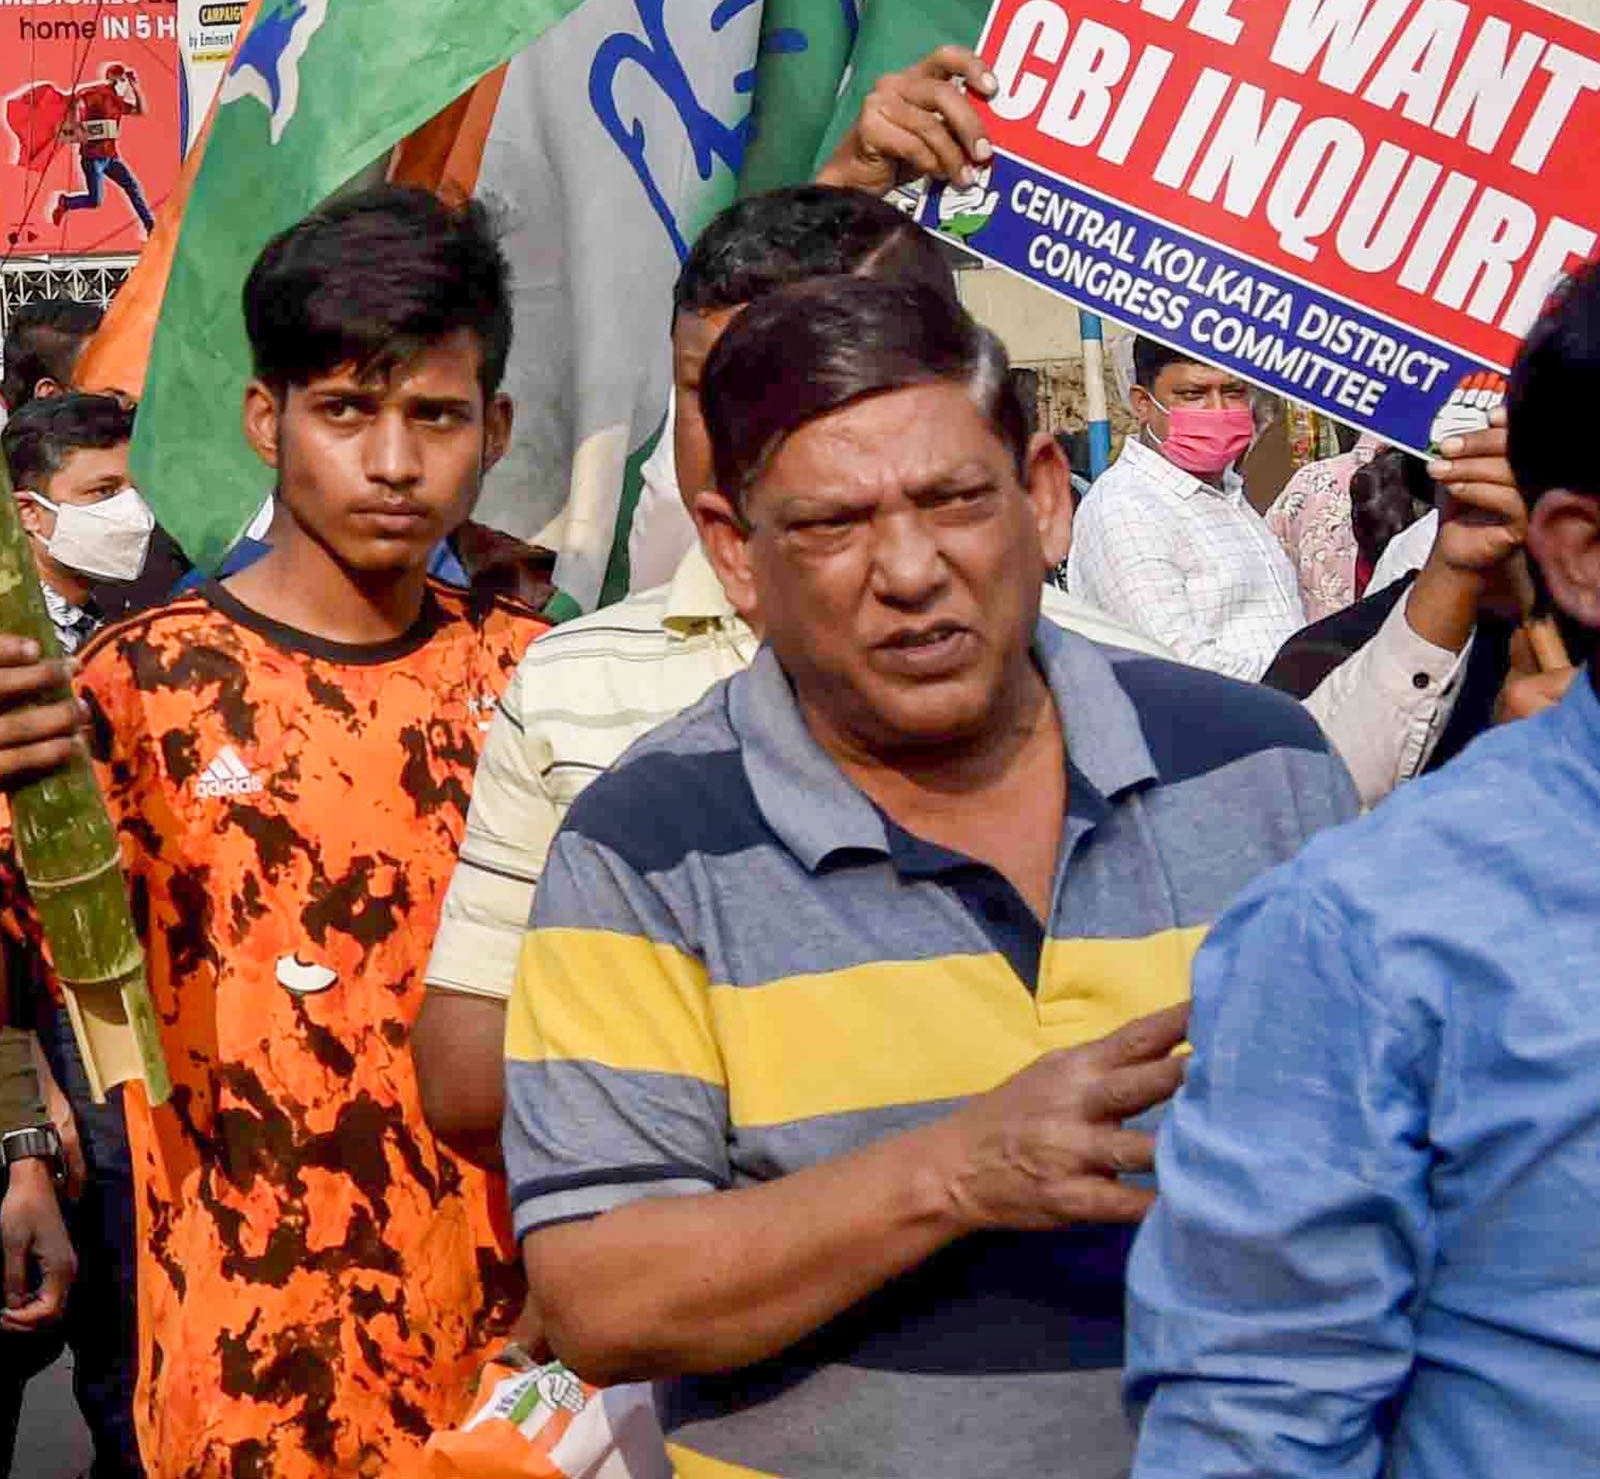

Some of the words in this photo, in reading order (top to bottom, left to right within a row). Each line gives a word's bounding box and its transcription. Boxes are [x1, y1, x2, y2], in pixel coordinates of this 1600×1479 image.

[19, 17, 96, 40] home
[103, 15, 129, 39] IN
[136, 14, 151, 38] 5
[157, 16, 178, 38] H
[202, 7, 243, 23] CAMPAIG
[1010, 179, 1146, 264] CENTRAL
[1141, 237, 1294, 335] KOLKATA
[1296, 304, 1449, 393] DISTRICT
[1028, 235, 1190, 330] CONGRESS
[1190, 307, 1388, 417] COMMITTEE
[196, 775, 264, 798] adidas
